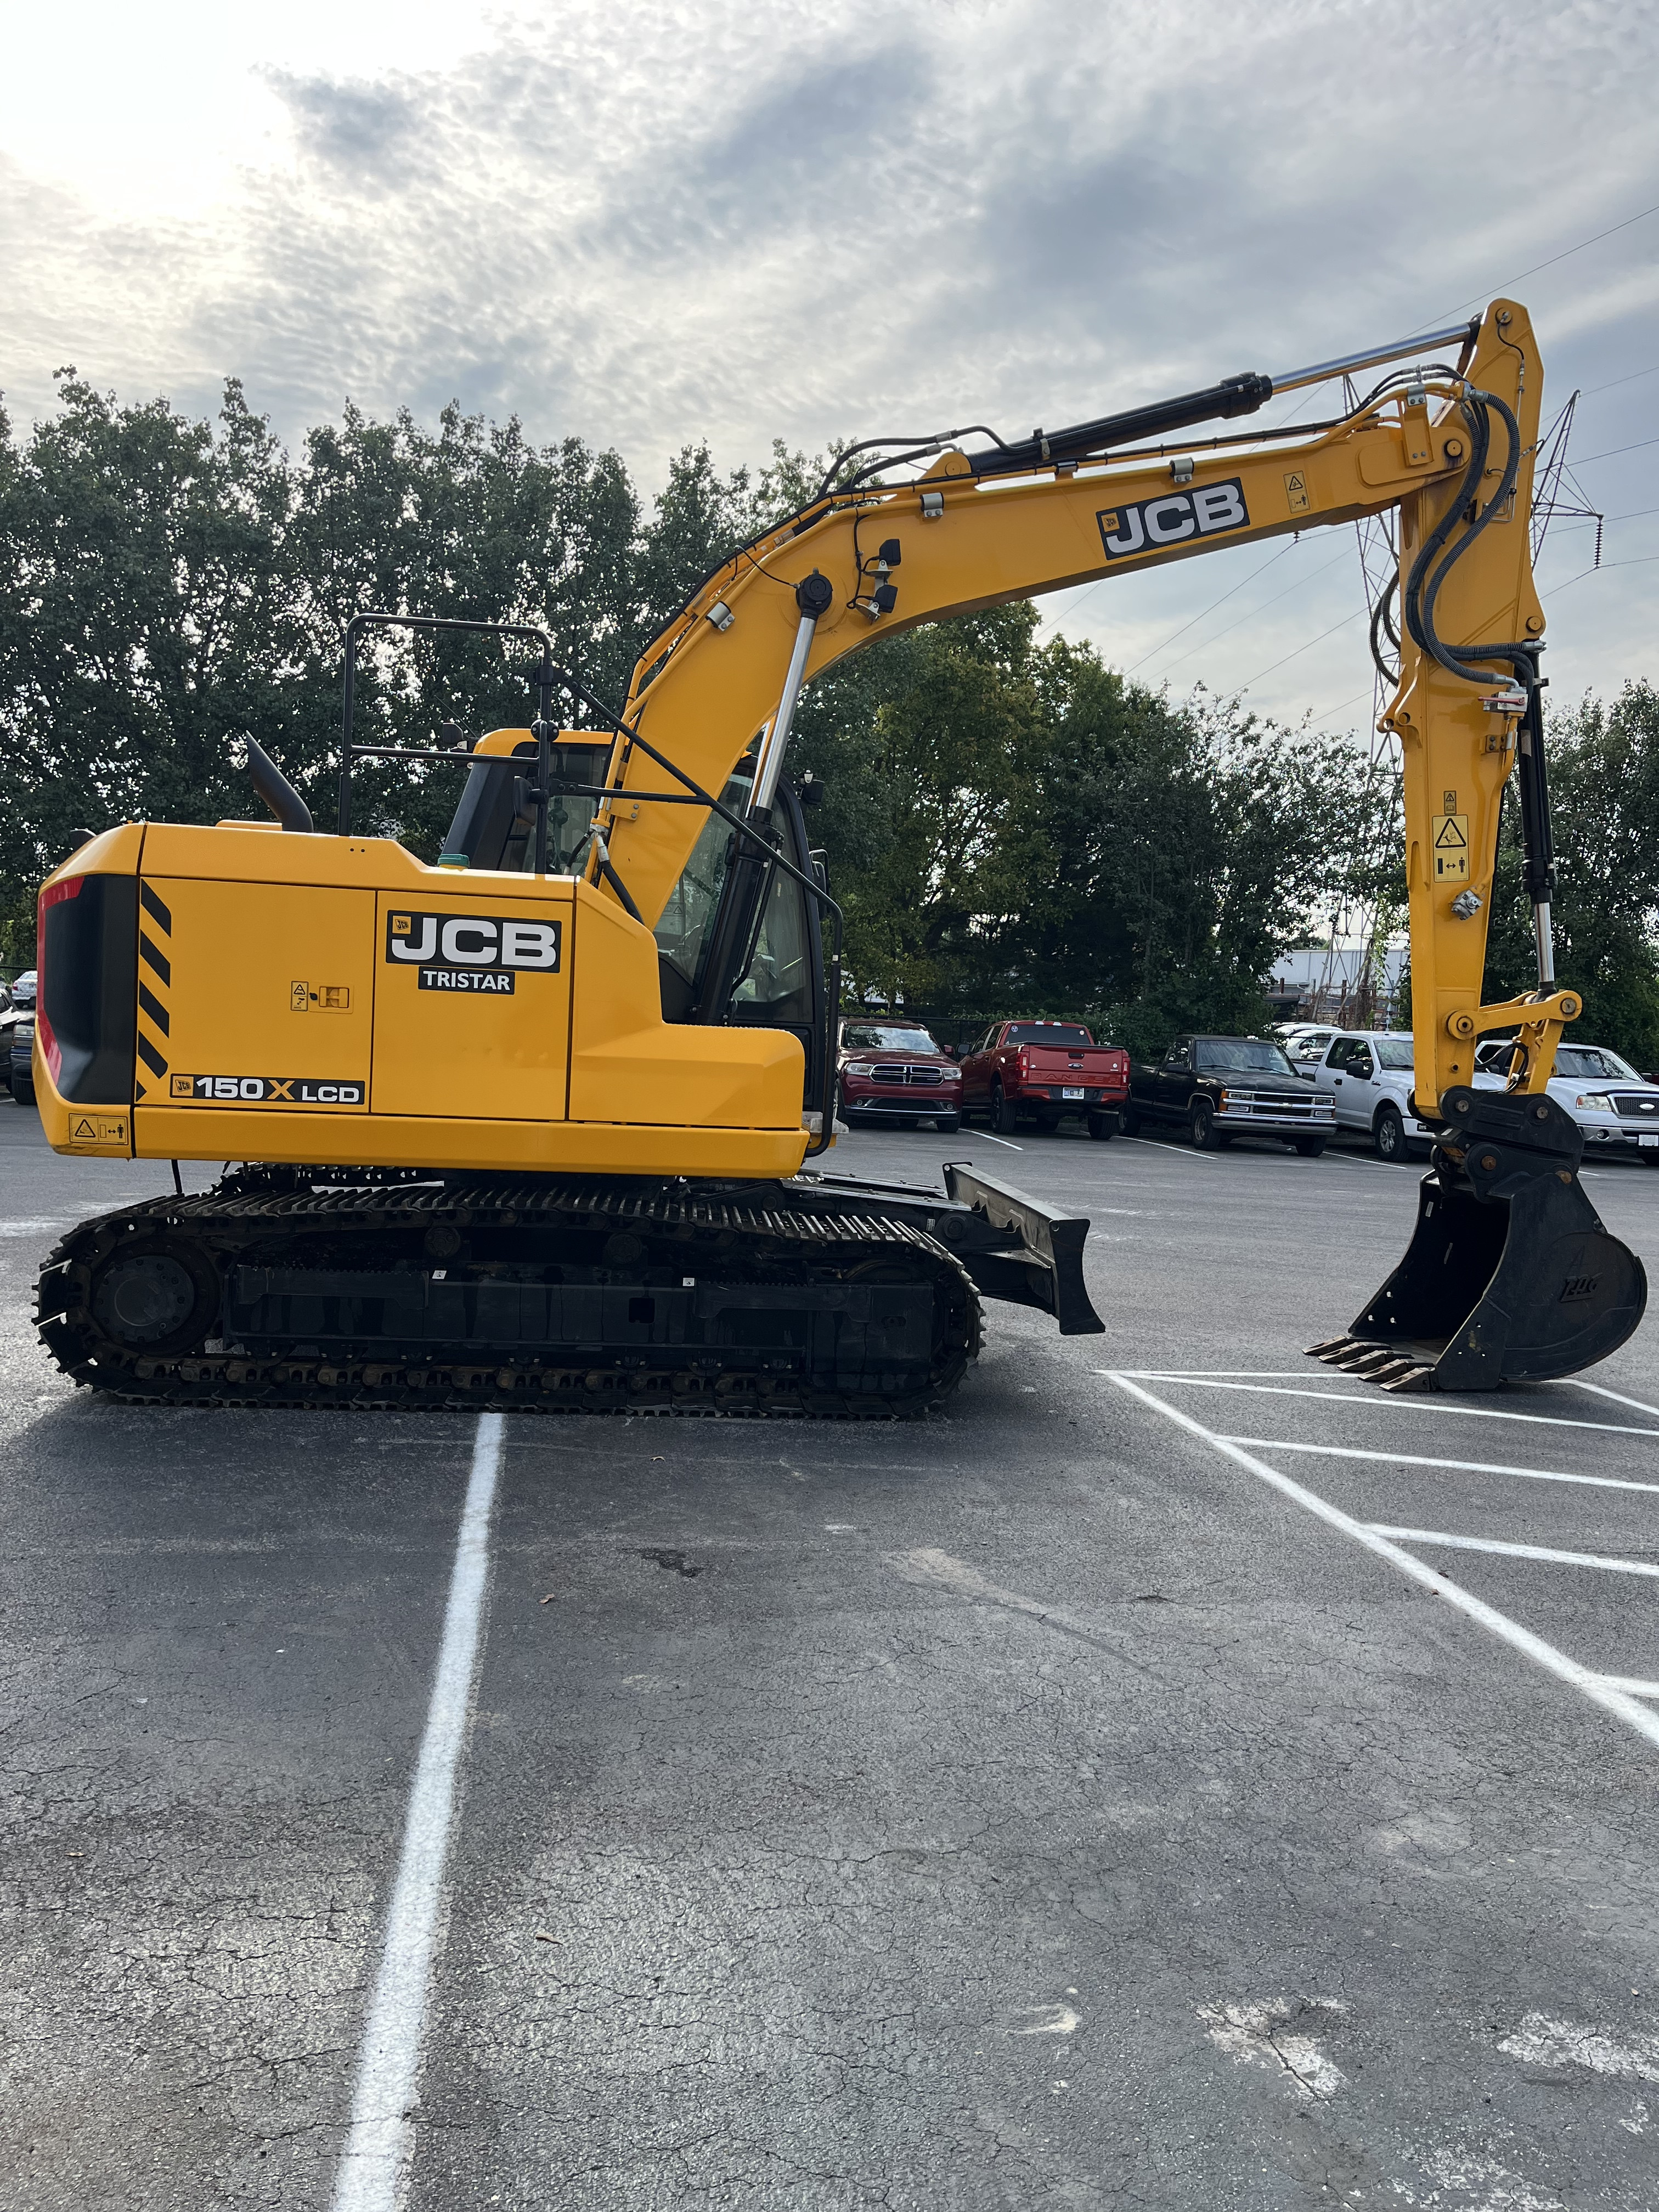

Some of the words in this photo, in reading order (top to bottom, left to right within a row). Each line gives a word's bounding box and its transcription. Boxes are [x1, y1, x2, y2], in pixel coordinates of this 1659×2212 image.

[1106, 484, 1245, 553] JCB
[392, 917, 556, 967] JCB
[423, 970, 510, 991] TRISTAR
[178, 1081, 191, 1091] JCB
[1031, 1073, 1120, 1084] RANGER
[302, 1086, 359, 1102] LCD
